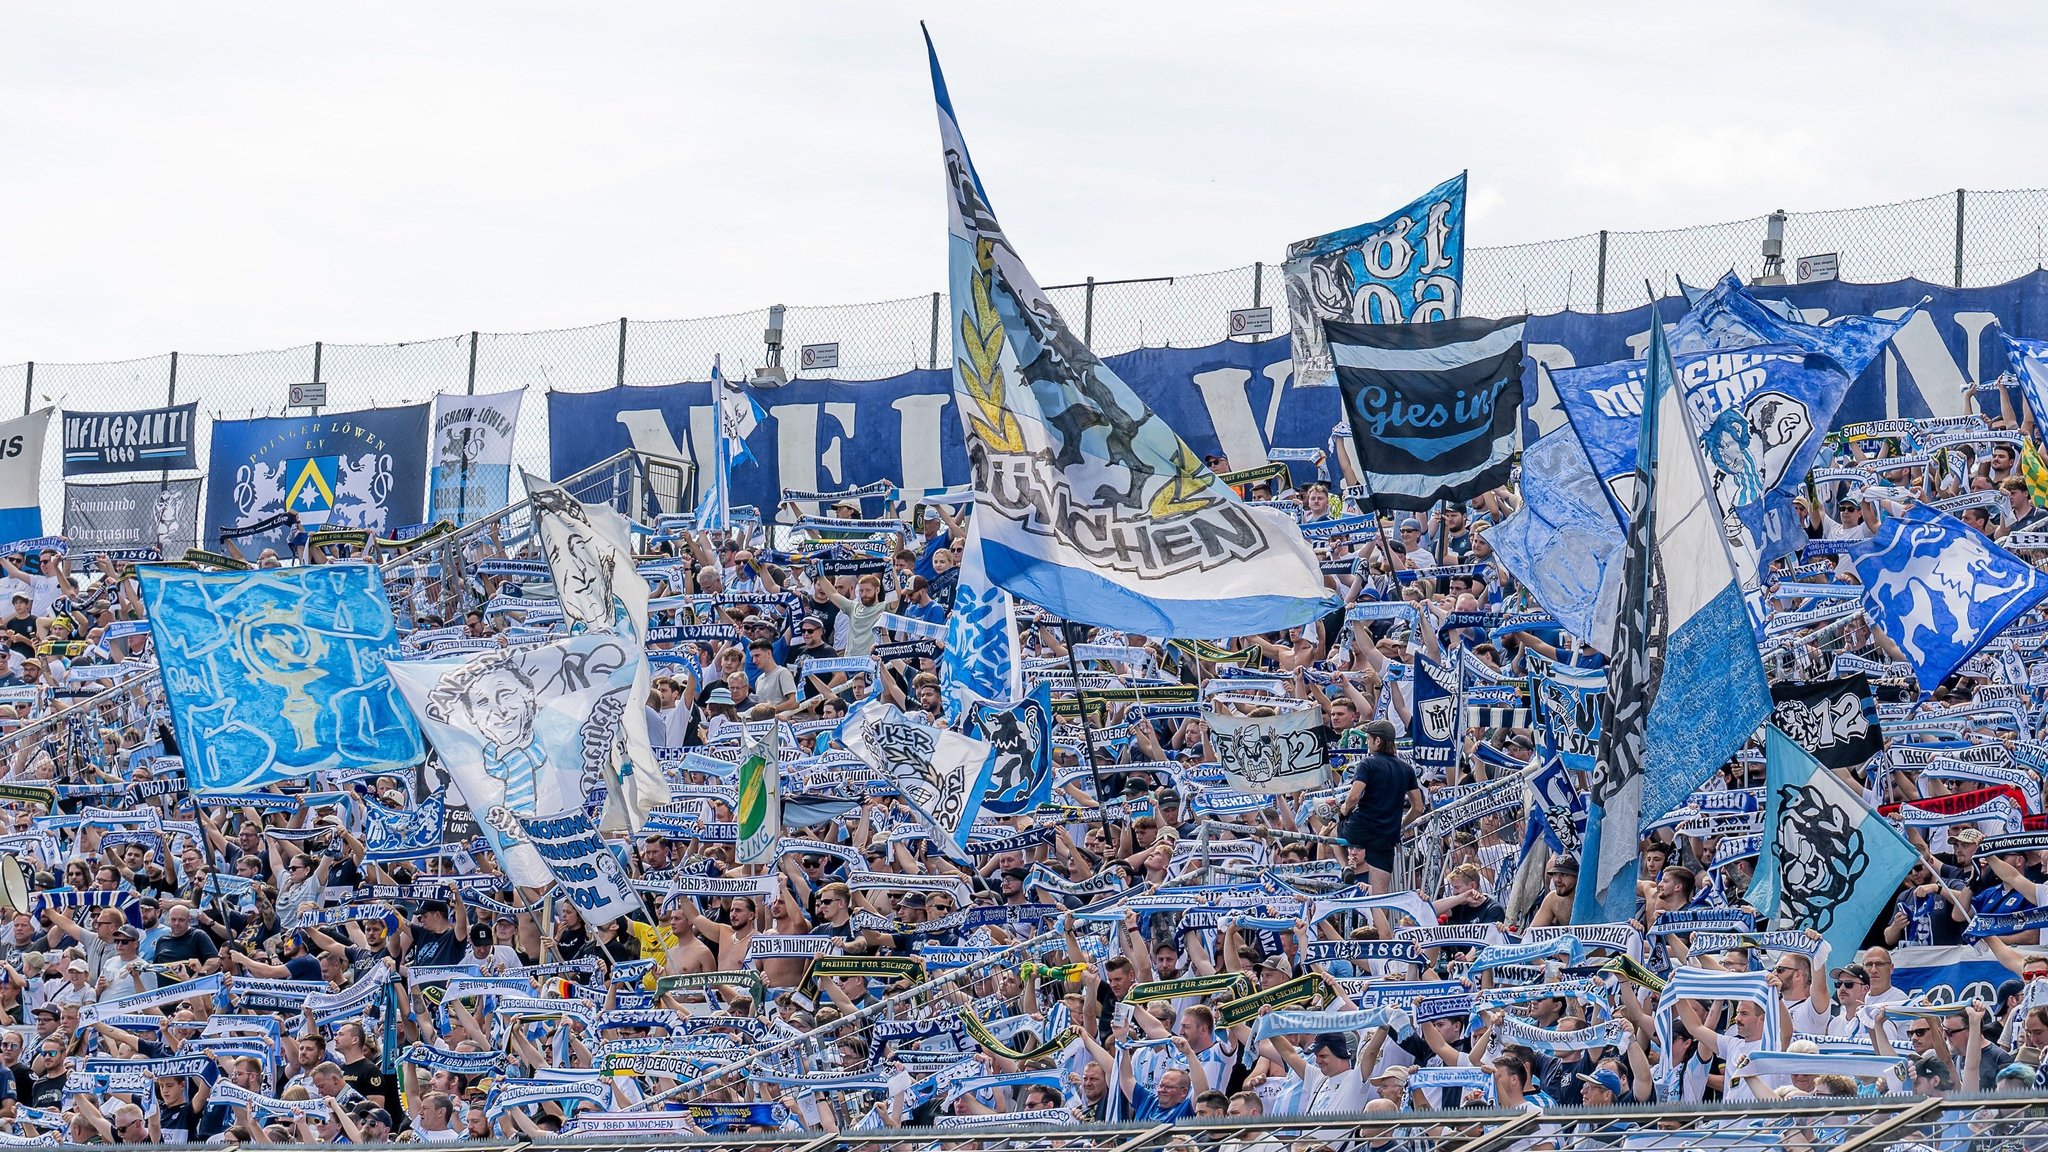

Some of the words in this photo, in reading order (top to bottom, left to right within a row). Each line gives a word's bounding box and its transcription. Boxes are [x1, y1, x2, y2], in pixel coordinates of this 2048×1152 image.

[66, 411, 188, 448] INFLAGRANTI
[1844, 424, 1866, 437] SIND
[1878, 423, 1896, 433] DER
[250, 422, 321, 464] POINGER
[331, 422, 386, 451] LÖWEN
[104, 447, 135, 463] 1860
[1237, 471, 1250, 479] FÜR
[1251, 467, 1276, 477] SECHZIG
[1349, 487, 1364, 495] TSV
[70, 497, 136, 512] Kommando
[213, 554, 226, 563] FÜR
[486, 562, 500, 570] TSV
[503, 563, 522, 571] 1860
[825, 563, 831, 571] In
[489, 600, 534, 608] DEUTSCHER
[1362, 606, 1380, 616] 1860
[816, 659, 833, 668] 1860
[1529, 657, 1557, 678] WE
[1812, 692, 1869, 748] 12
[1414, 746, 1449, 761] STEHT
[1943, 760, 1983, 775] MEISTER
[140, 781, 166, 797] 1860
[1705, 793, 1747, 808] 1860
[450, 823, 467, 834] UNS
[704, 824, 719, 839] ARE
[1981, 841, 1995, 851] TSV
[1996, 839, 2028, 848] MÜNCHEN
[677, 876, 700, 890] 1860
[709, 878, 758, 891] MÜNCHEN
[1079, 872, 1114, 891] 1860
[373, 885, 399, 897] BOAZN
[413, 885, 440, 898] SPORT
[1186, 912, 1224, 928] CHENS
[1667, 912, 1693, 923] 1860
[1433, 925, 1489, 940] MÜNCHEN
[1658, 921, 1703, 932] GRÜNWALDER
[1531, 926, 1561, 943] 1860
[1575, 927, 1633, 945] MÜNCHEN
[783, 938, 835, 954] MÜNCHEN
[1368, 942, 1419, 958] 1860
[1481, 945, 1525, 962] SECHZIG
[821, 960, 860, 968] FREIHEIT
[861, 960, 879, 968] FÜR
[881, 961, 914, 971] SECHZIG
[249, 981, 272, 990] 1860
[274, 983, 322, 993] MÜNCHEN
[491, 979, 527, 992] München
[673, 978, 691, 987] FÜR
[692, 977, 706, 986] EIN
[1144, 982, 1178, 993] FREIHEIT
[1179, 980, 1196, 989] FÜR
[155, 982, 197, 1001] München
[1259, 994, 1272, 1006] FÜR
[1274, 984, 1304, 1000] SECHZIG
[251, 996, 276, 1005] 1860
[536, 1000, 569, 1010] MEISTER
[427, 1052, 442, 1063] TSV
[443, 1056, 463, 1066] 1860
[610, 1056, 633, 1070] SIND
[647, 1057, 667, 1070] DER
[152, 1059, 207, 1075] MÜNCHEN
[502, 1085, 544, 1101] DEUTSCHER
[546, 1083, 580, 1094] MEISTER
[580, 1083, 601, 1094] 1966
[691, 1106, 715, 1118] Blue
[581, 1121, 601, 1131] TSV
[603, 1121, 626, 1130] 1860
[627, 1119, 674, 1130] MÜNCHEN
